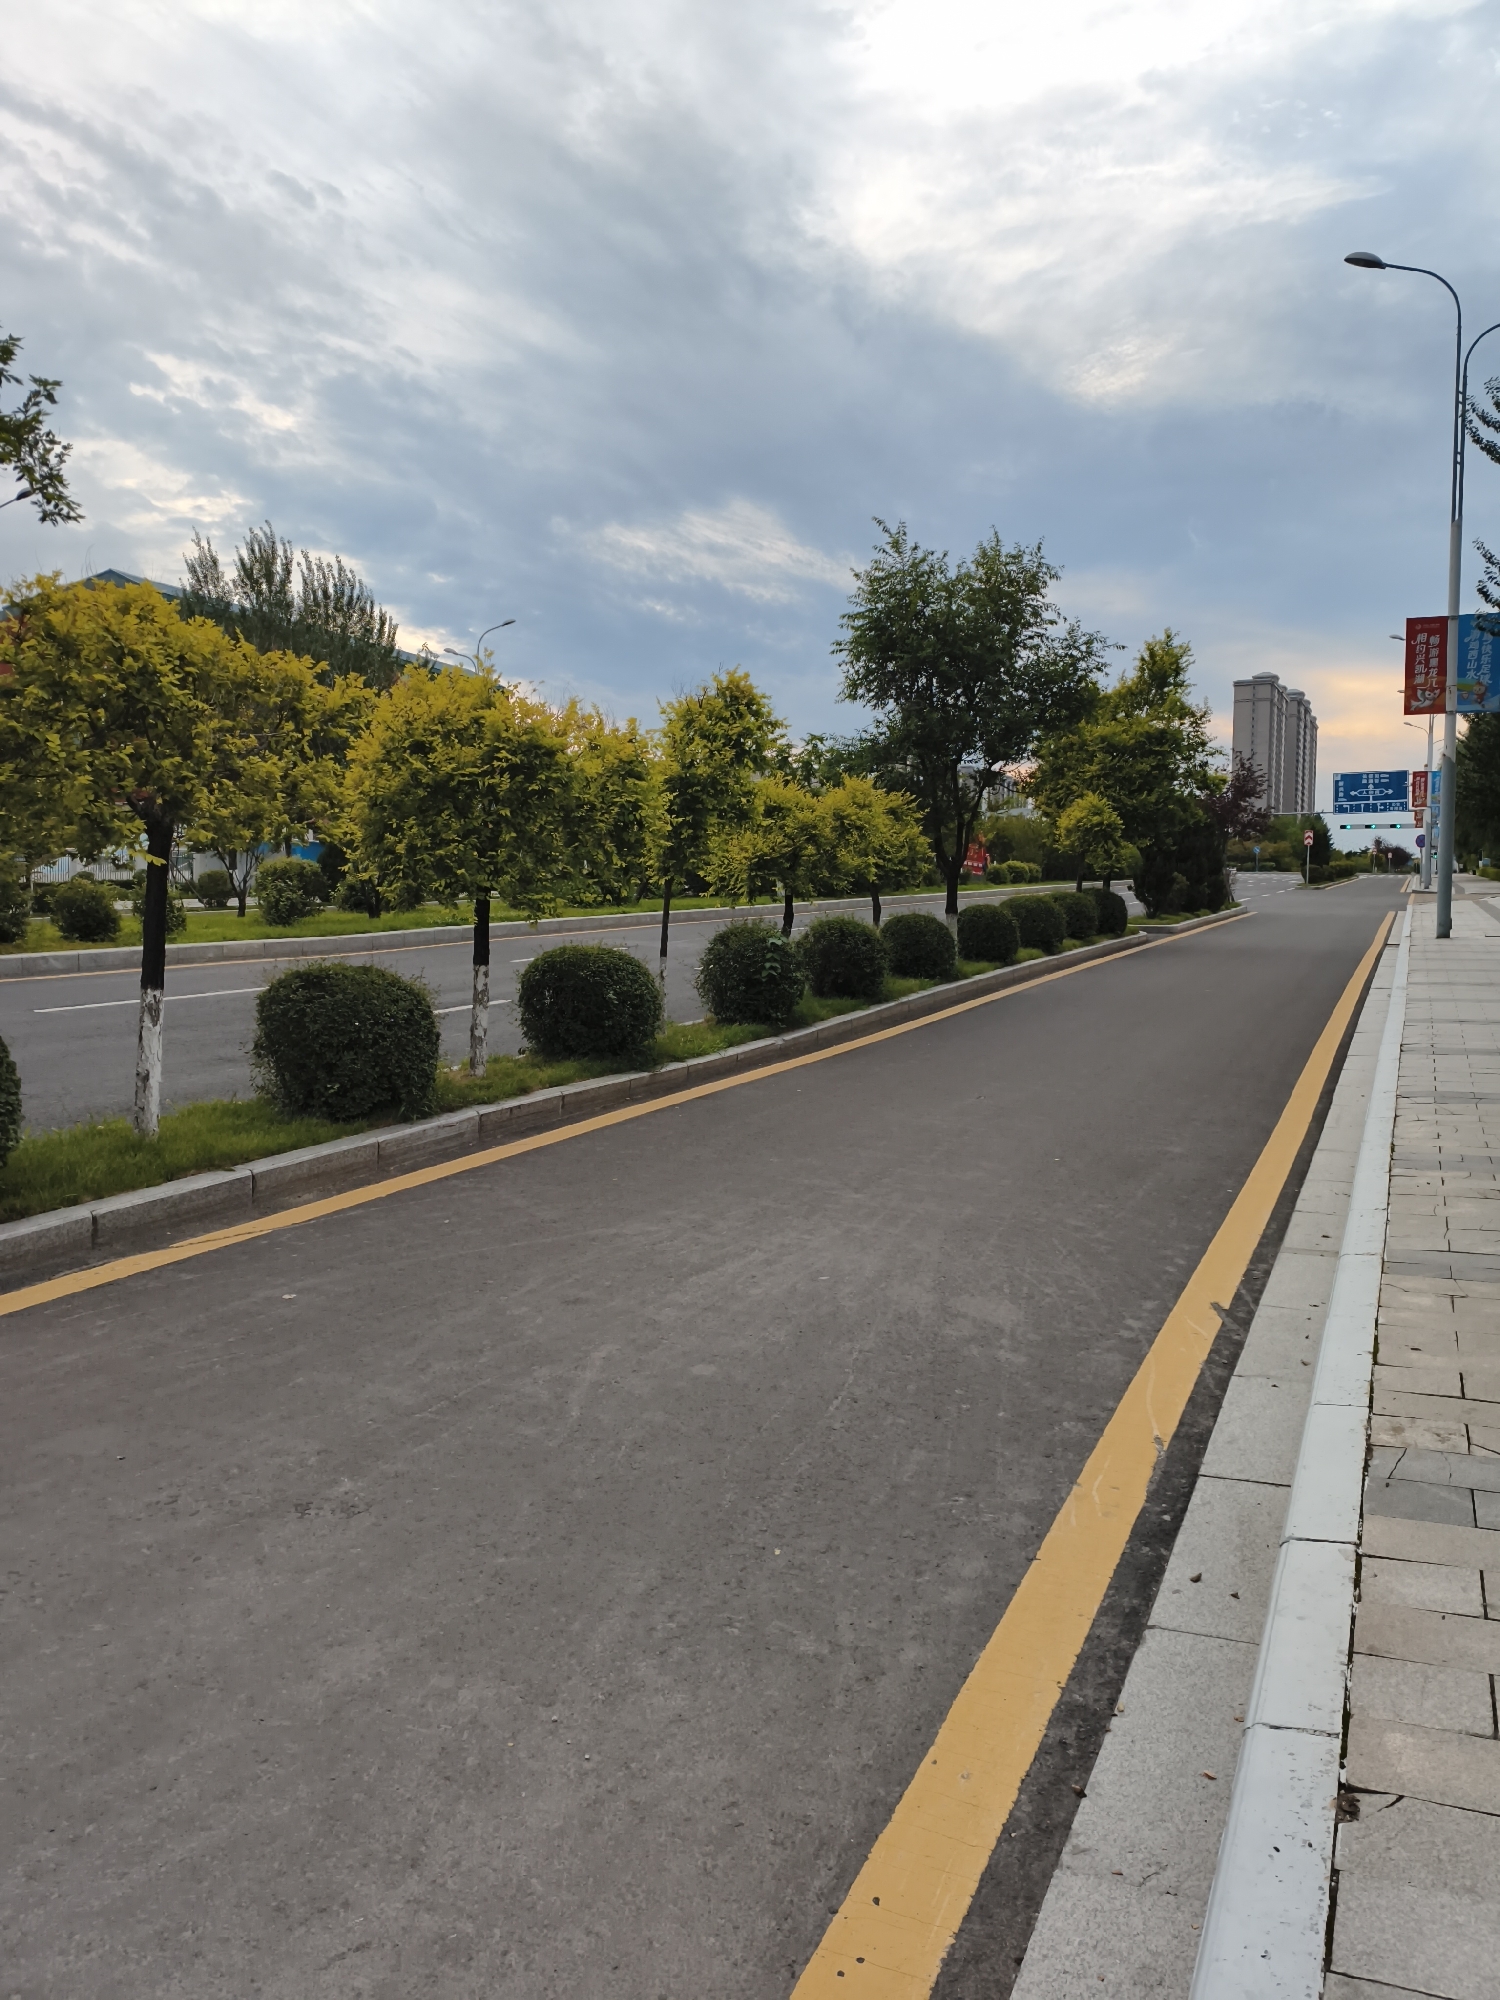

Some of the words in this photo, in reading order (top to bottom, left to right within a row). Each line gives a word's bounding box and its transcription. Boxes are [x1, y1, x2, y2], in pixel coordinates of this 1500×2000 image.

[1411, 632, 1428, 685] 相约兴凯湖
